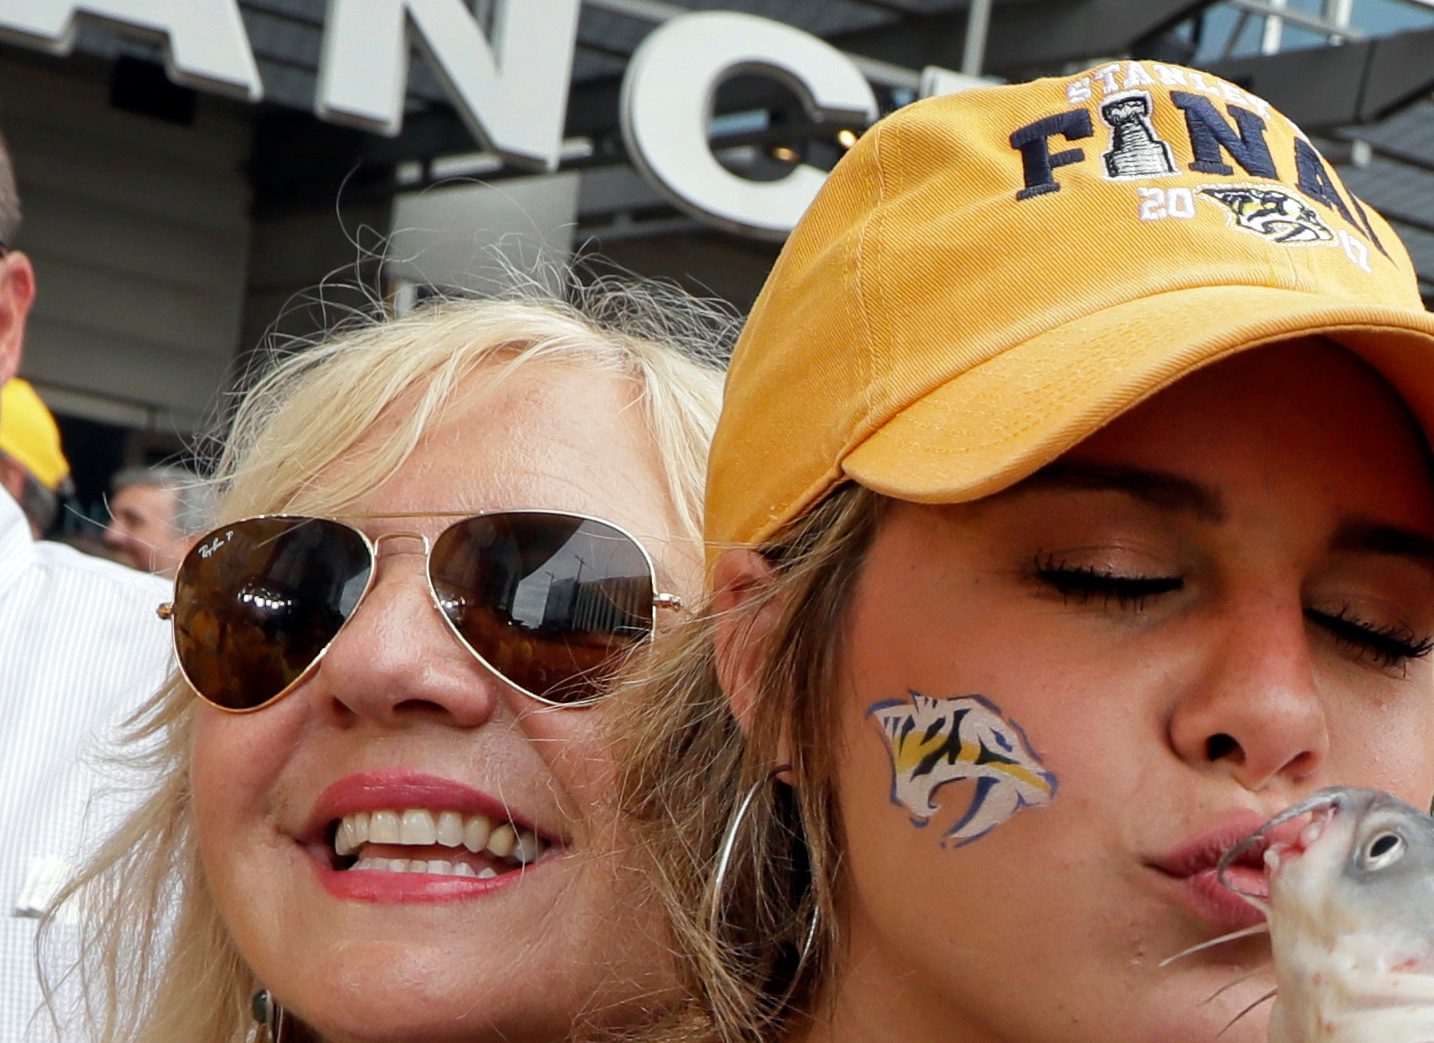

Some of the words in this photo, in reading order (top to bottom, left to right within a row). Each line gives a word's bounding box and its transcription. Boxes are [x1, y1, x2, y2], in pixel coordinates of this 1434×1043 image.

[1066, 61, 1272, 120] STANLEY
[1137, 187, 1195, 221] 20
[1338, 228, 1372, 273] 17
